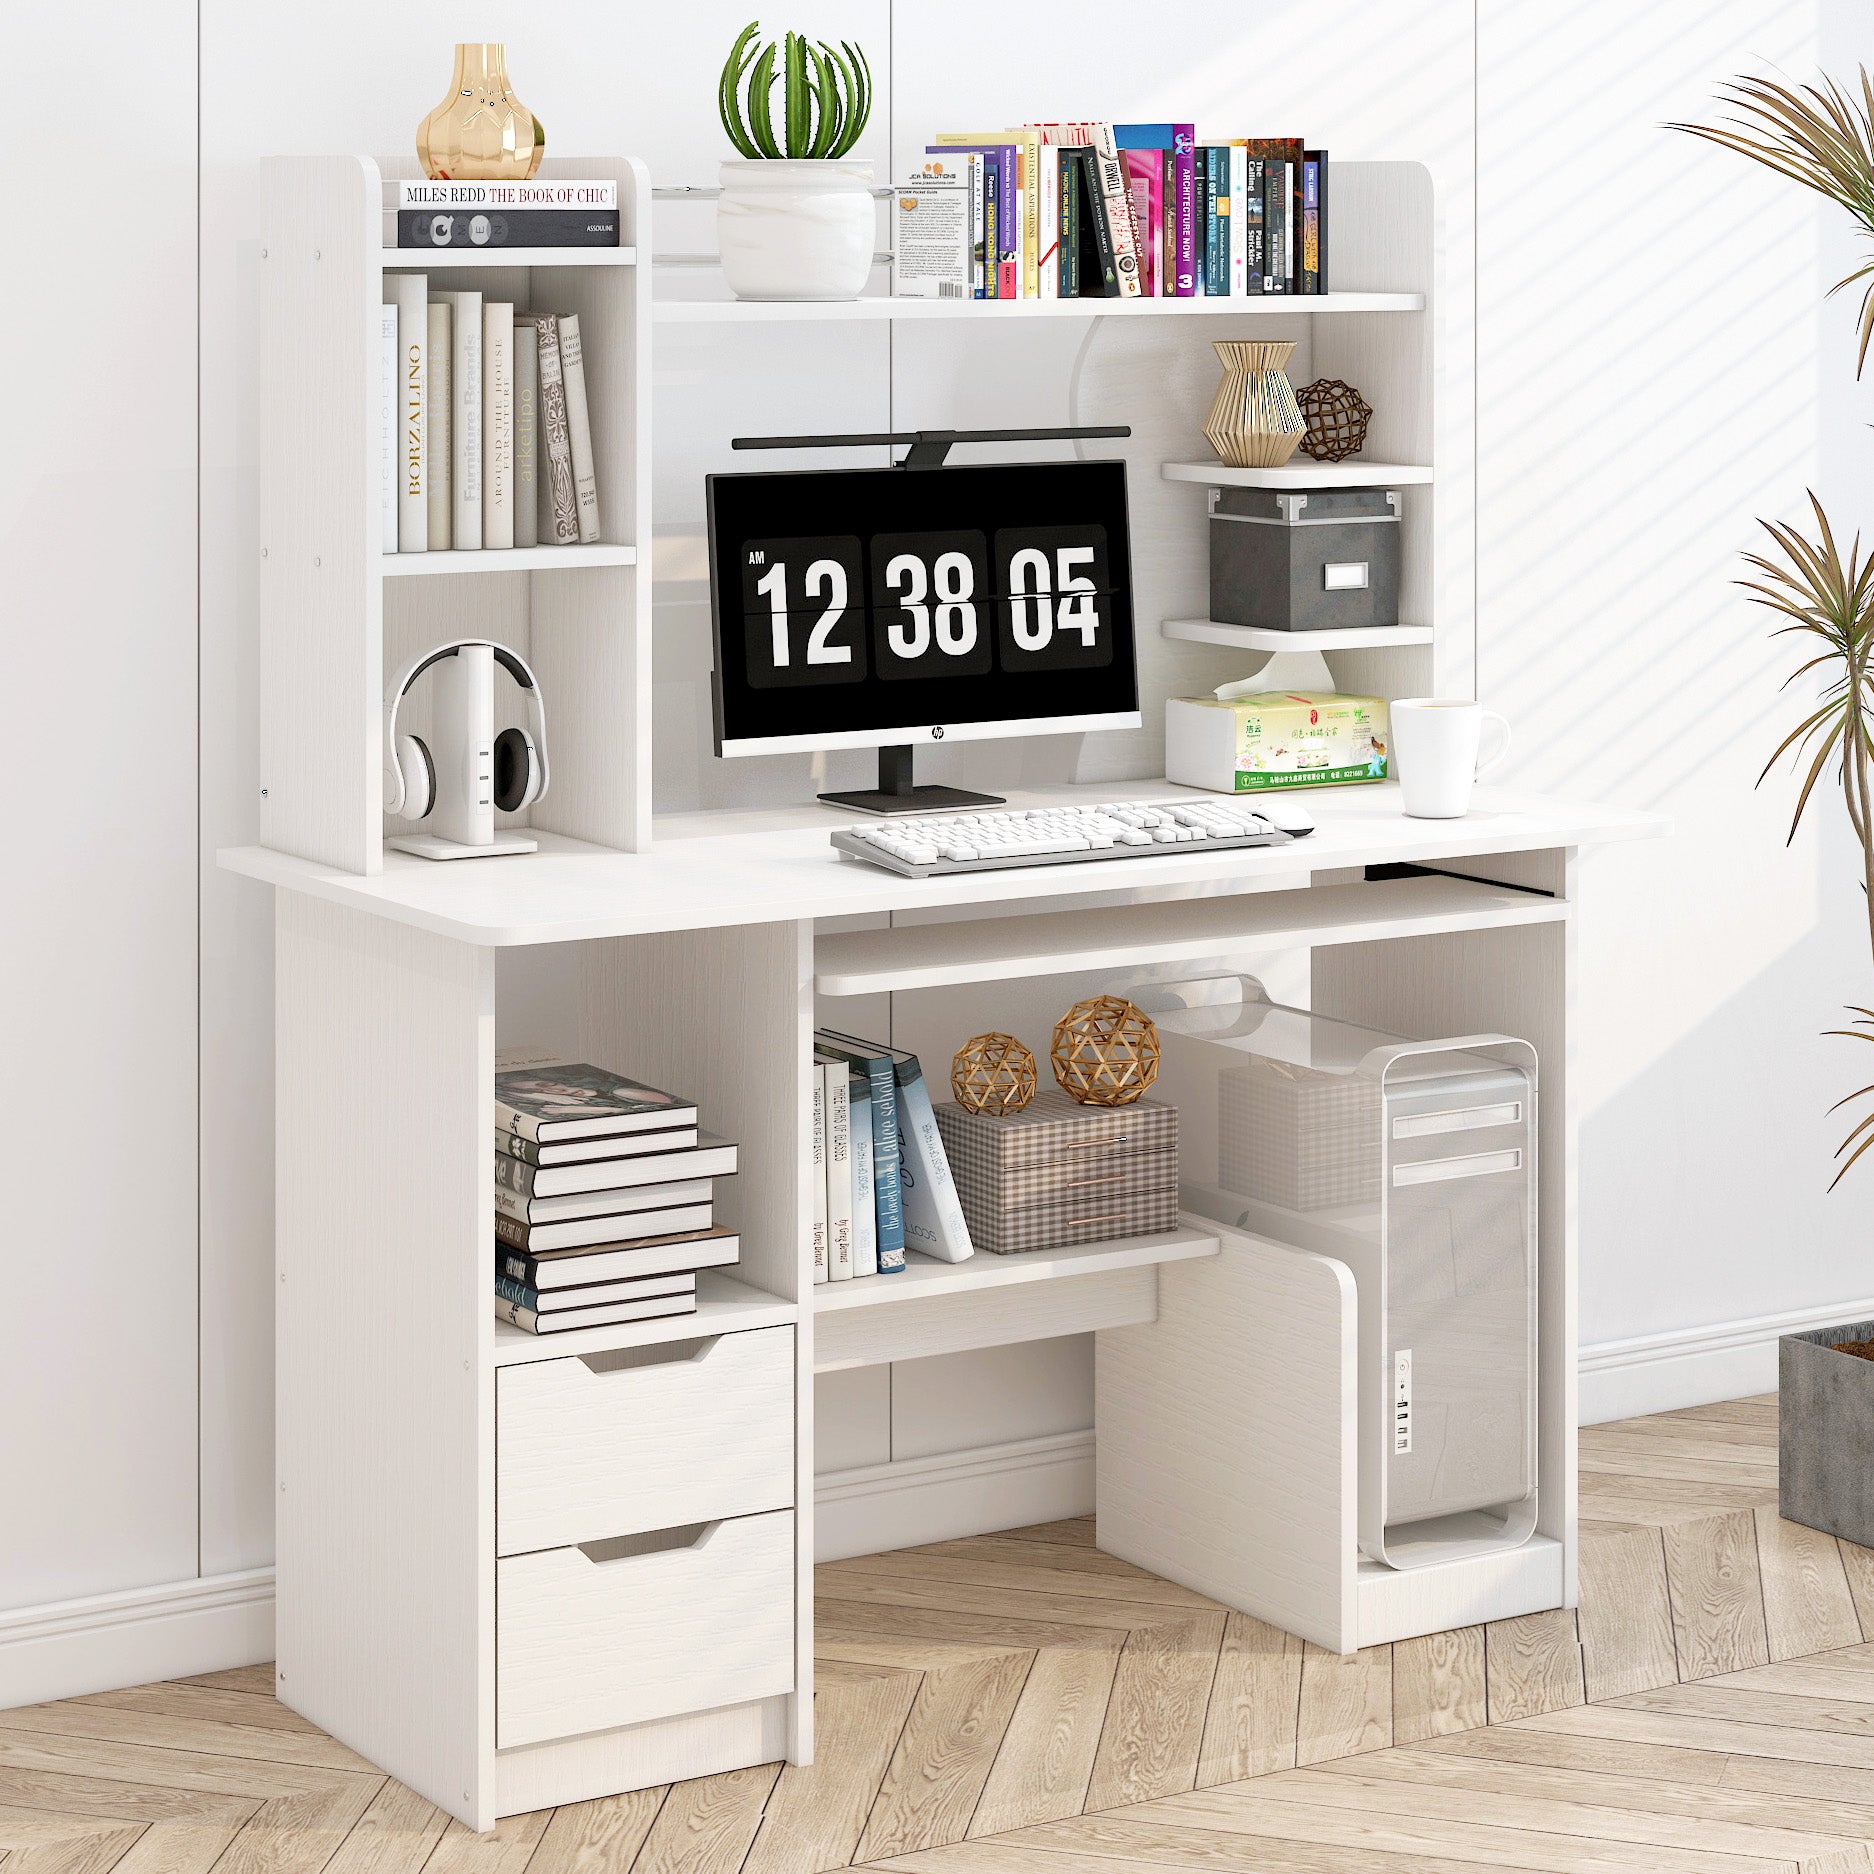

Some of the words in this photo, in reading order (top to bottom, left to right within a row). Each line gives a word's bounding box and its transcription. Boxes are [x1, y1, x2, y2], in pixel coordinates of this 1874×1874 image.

[1208, 149, 1217, 180] RIDERS
[1091, 176, 1099, 192] AND
[1105, 163, 1120, 191] ORWELL
[1247, 161, 1256, 192] Calling
[407, 188, 447, 202] MILES
[451, 188, 485, 202] REDD
[490, 189, 514, 202] THE
[520, 189, 553, 202] BOOK
[558, 189, 573, 202] OF
[577, 189, 607, 202] CHIC
[976, 188, 981, 198] AT
[1126, 188, 1134, 202] THE
[1208, 182, 1217, 194] ON
[1182, 168, 1191, 235] ARCHITECTURE
[1208, 195, 1217, 213] THE
[1235, 198, 1243, 225] Love
[987, 202, 995, 230] HONG
[1129, 206, 1139, 240] SECRETS
[586, 224, 614, 232] ASSOULINE
[1208, 214, 1217, 243] STORM
[987, 232, 995, 259] KONG
[1134, 242, 1143, 258] OUT
[1182, 237, 1191, 262] NOW!
[1234, 227, 1243, 253] Slow
[1248, 229, 1256, 267] Strickler
[1256, 251, 1263, 263] M.
[987, 261, 995, 297] NIGHTS
[464, 334, 476, 405] Brands
[409, 345, 420, 496] BORZALINO
[517, 388, 534, 482] arketipo
[464, 411, 476, 502] Furniture
[748, 551, 765, 565] AM
[757, 559, 852, 667] 12
[886, 551, 978, 659] 38
[932, 725, 945, 740] hp
[833, 1084, 846, 1104] THREE
[870, 1070, 895, 1116] sebold
[834, 1106, 846, 1123] PAIRS
[834, 1125, 846, 1133] OF
[874, 1120, 896, 1152] alice
[922, 1123, 934, 1142] FATHER
[834, 1134, 847, 1162] GLASSES
[857, 1142, 868, 1160] FATHER
[928, 1143, 937, 1151] MY
[930, 1151, 940, 1159] OF
[857, 1160, 868, 1169] MY
[932, 1159, 945, 1177] GHOST
[858, 1175, 868, 1191] GHOST
[879, 1162, 898, 1189] bones
[937, 1177, 946, 1185] THE
[858, 1191, 868, 1201] THE
[881, 1190, 900, 1215] lovely
[835, 1219, 849, 1228] by
[882, 1216, 899, 1230] the
[836, 1227, 848, 1242] Greg
[839, 1243, 849, 1263] Bennet
[496, 1278, 526, 1305] ebold
